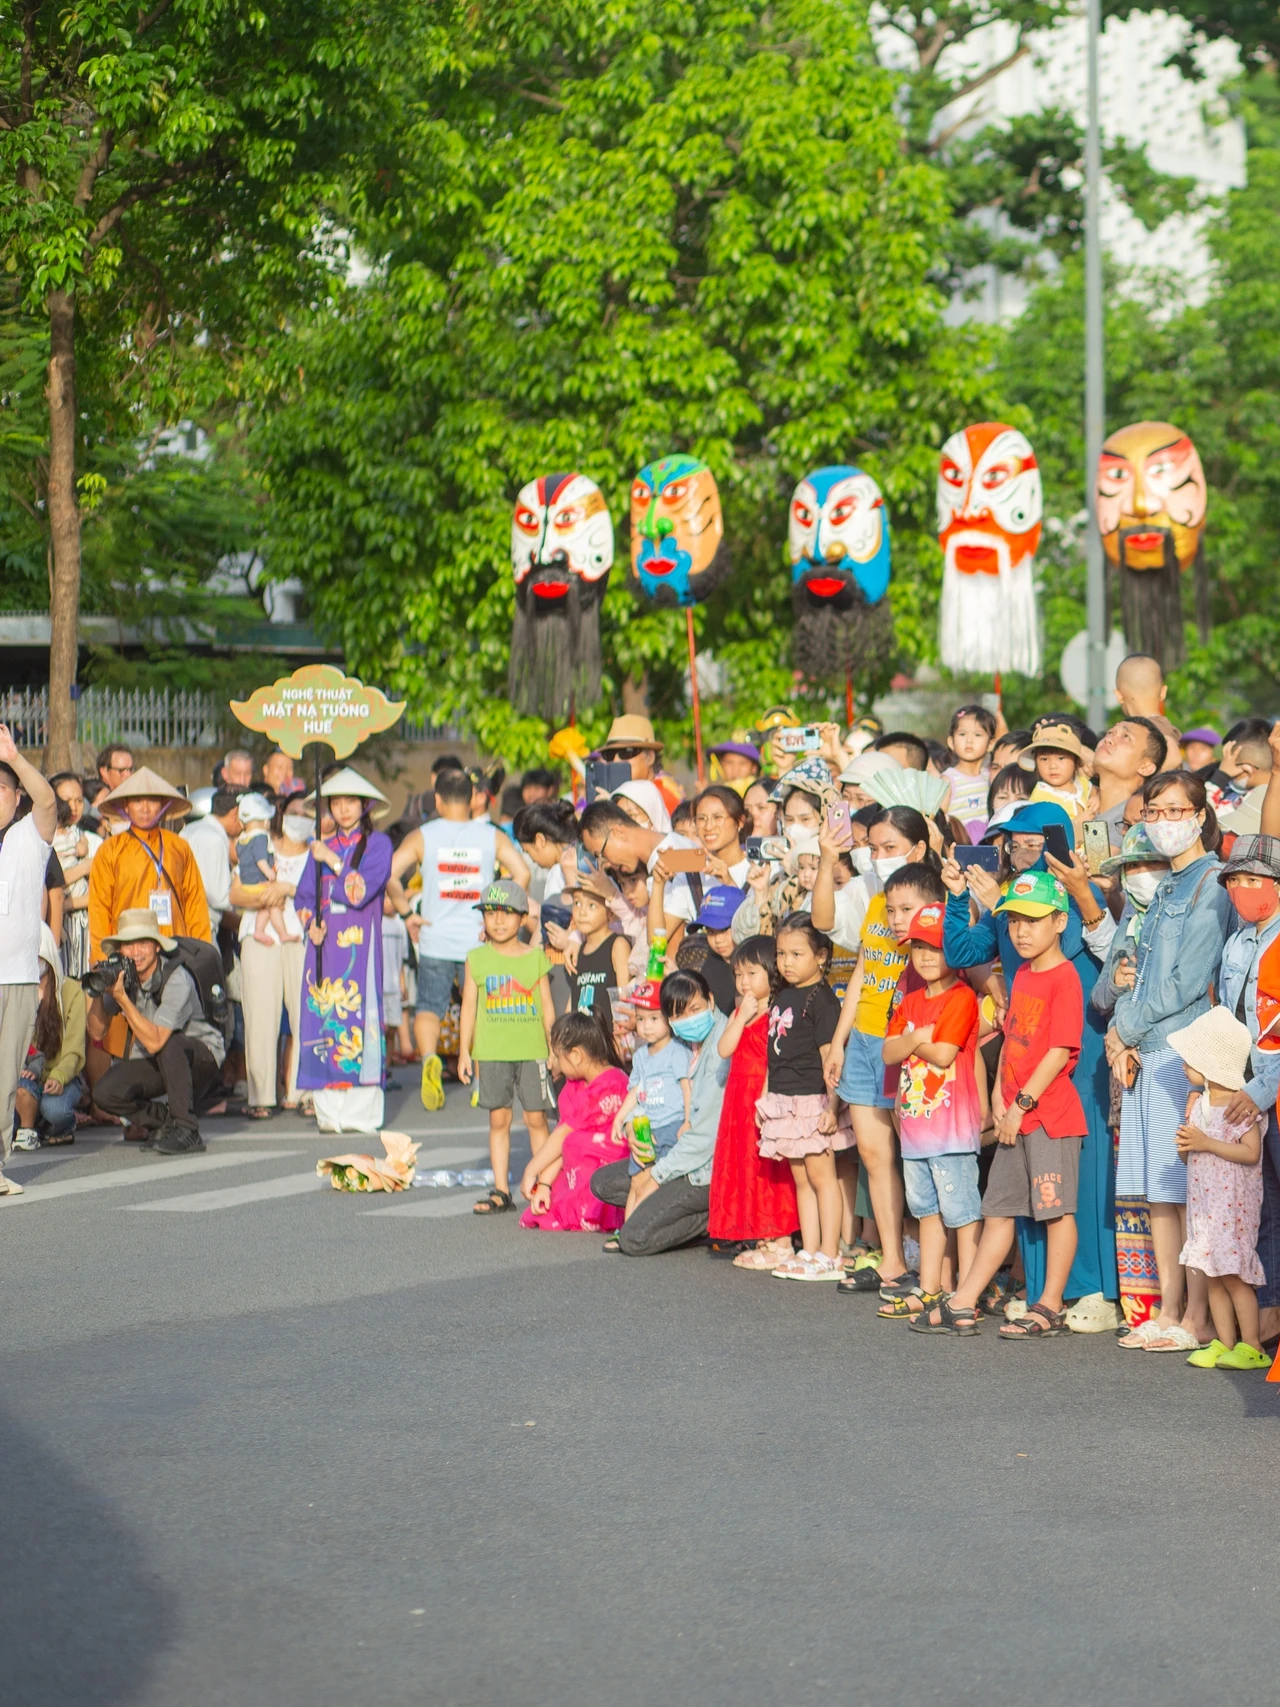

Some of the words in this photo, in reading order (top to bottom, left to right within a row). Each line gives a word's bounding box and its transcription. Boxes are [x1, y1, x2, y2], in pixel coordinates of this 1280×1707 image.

[282, 687, 313, 701] NGHỆ
[262, 701, 294, 719] MẶT
[297, 704, 318, 719] NẠ
[304, 718, 333, 734] HUẾ
[884, 950, 910, 966] girl
[1033, 1172, 1062, 1188] PLACE
